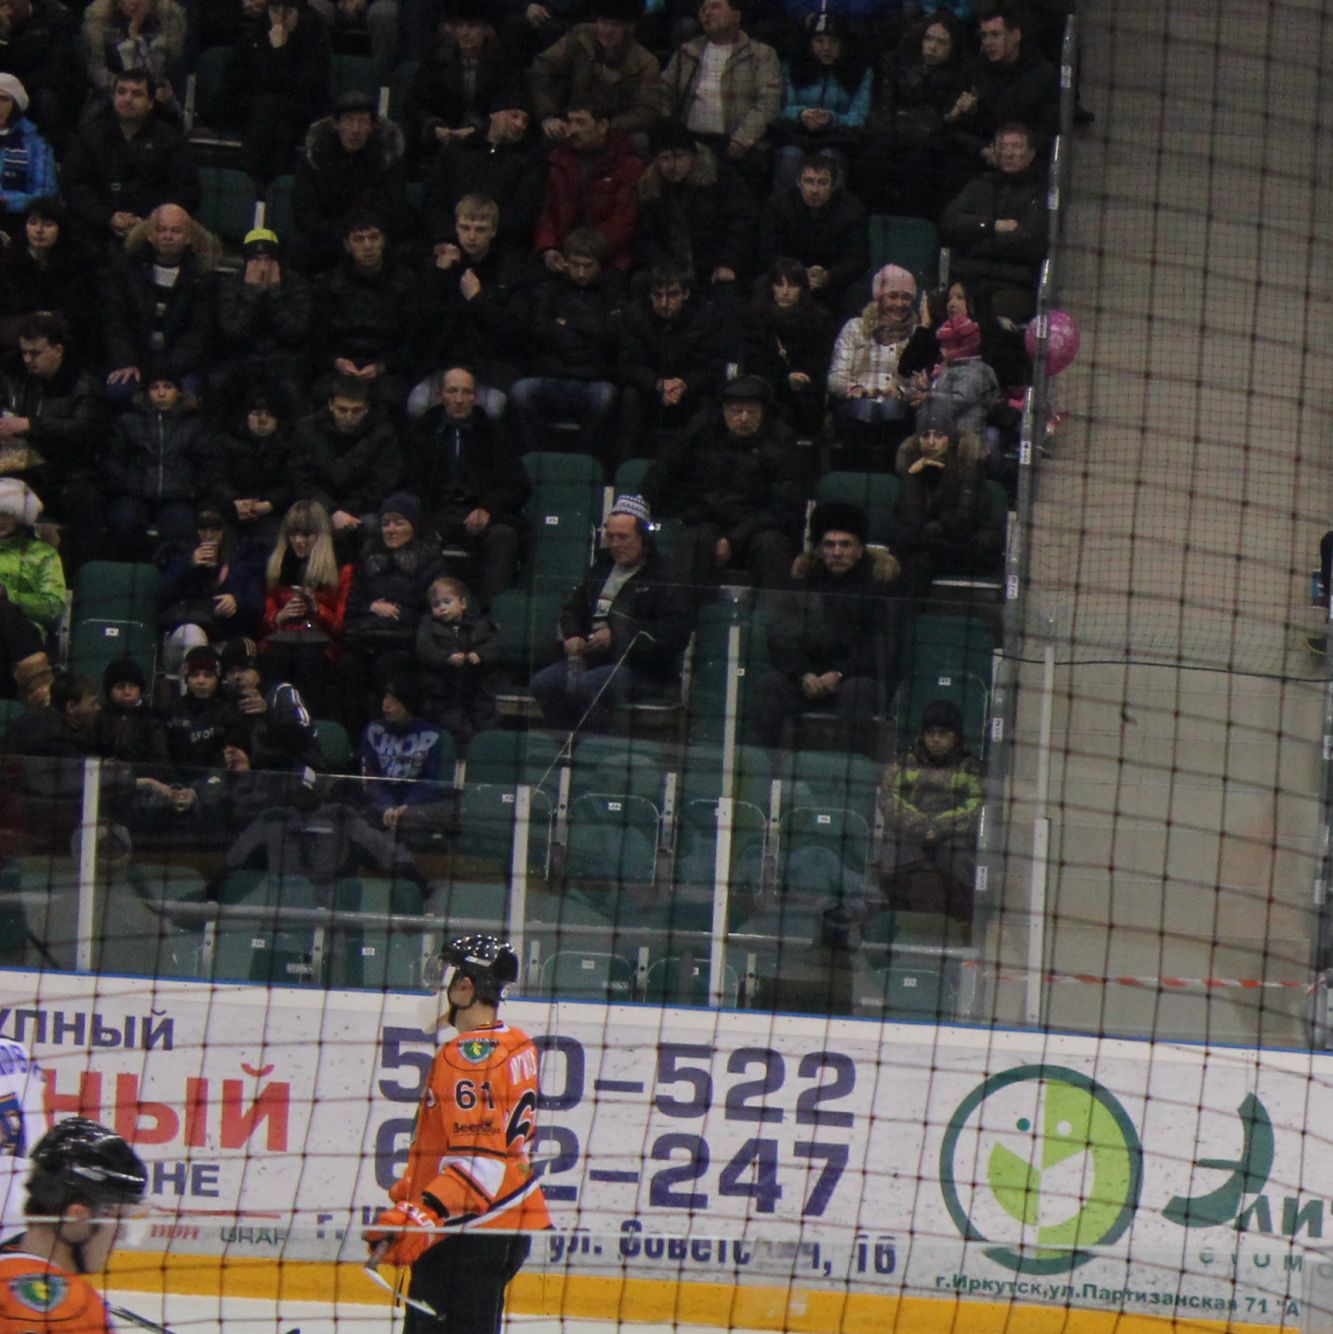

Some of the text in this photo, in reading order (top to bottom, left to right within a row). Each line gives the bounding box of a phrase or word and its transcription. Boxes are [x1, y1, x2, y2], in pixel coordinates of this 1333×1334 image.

[379, 1026, 856, 1128] 50-522
[455, 1079, 496, 1111] 61
[375, 1118, 850, 1217] 62-247
[1245, 1297, 1268, 1314] 71
